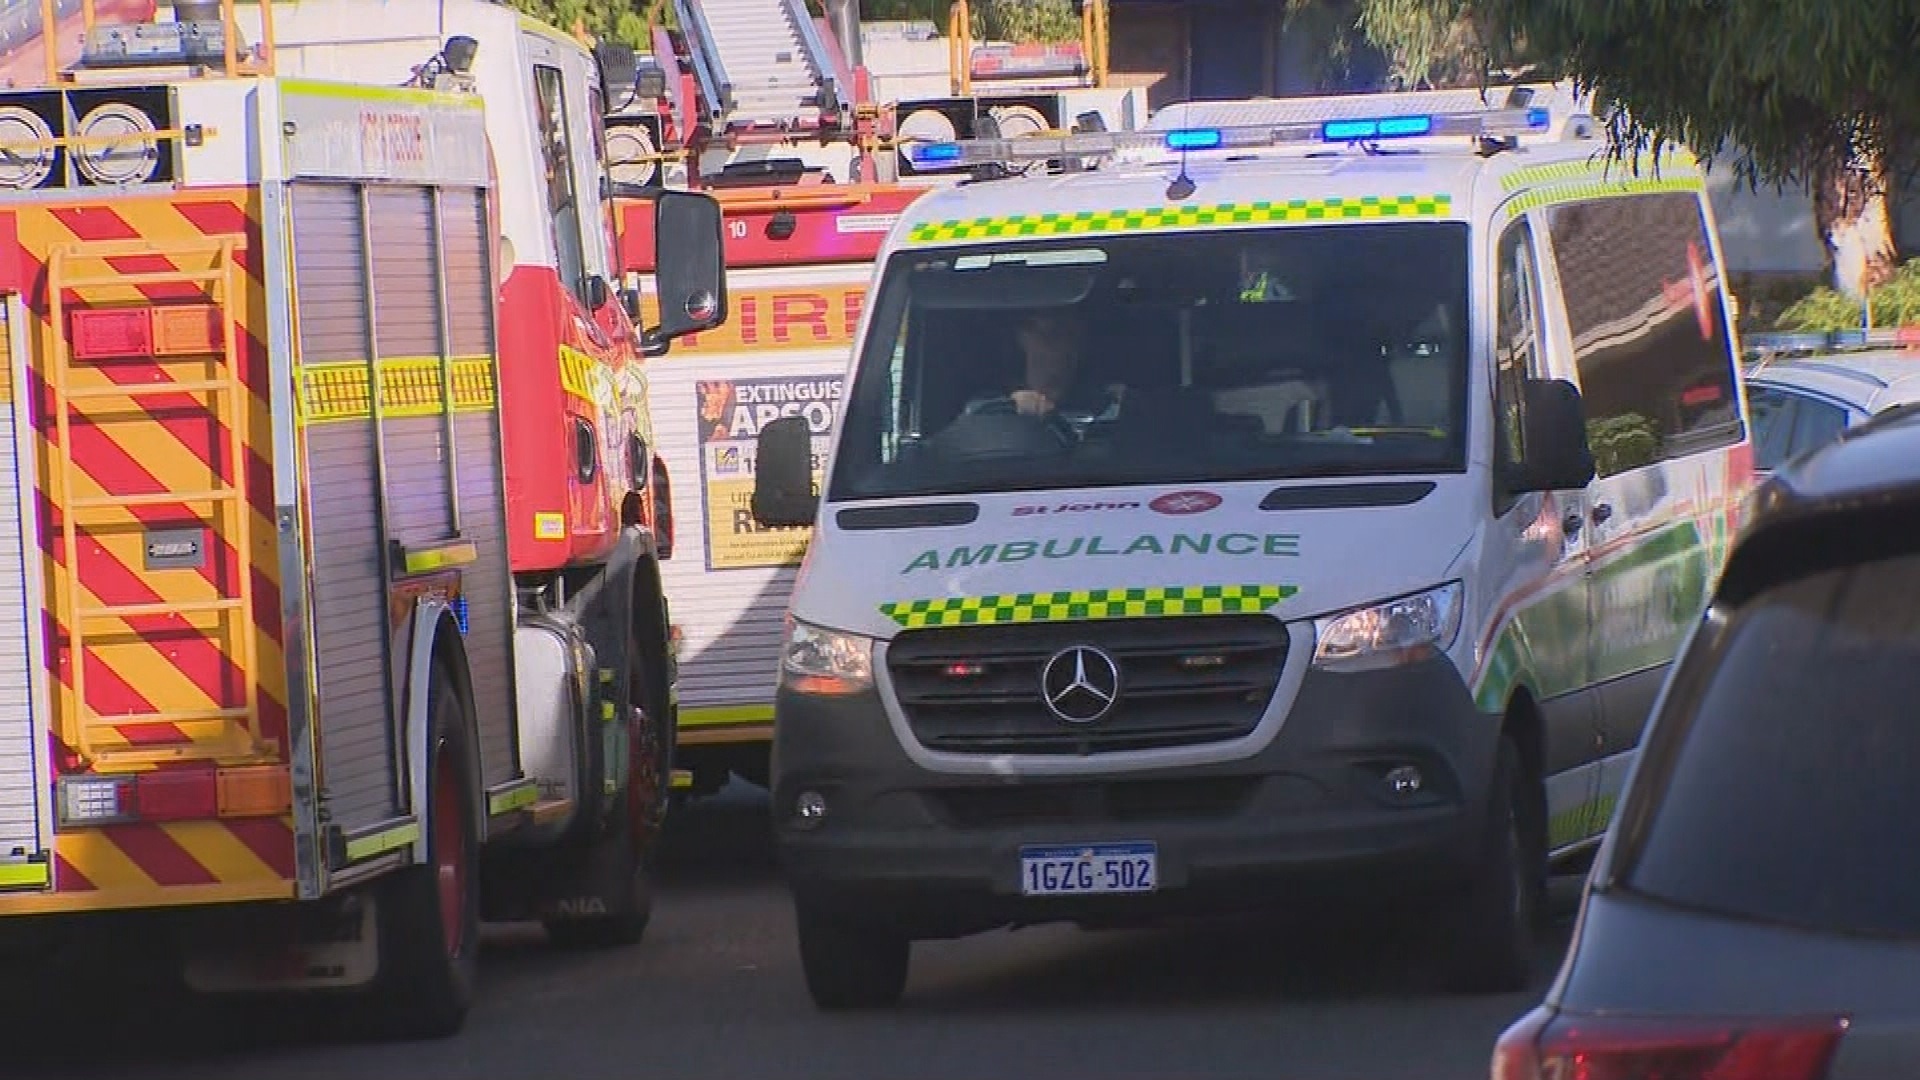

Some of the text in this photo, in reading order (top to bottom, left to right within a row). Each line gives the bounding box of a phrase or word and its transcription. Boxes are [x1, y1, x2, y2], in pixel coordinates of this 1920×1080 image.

[728, 221, 747, 238] 10
[682, 291, 866, 347] IR
[730, 401, 840, 436] ARO
[1011, 501, 1141, 517] St John
[901, 532, 1301, 574] AMBULANCE
